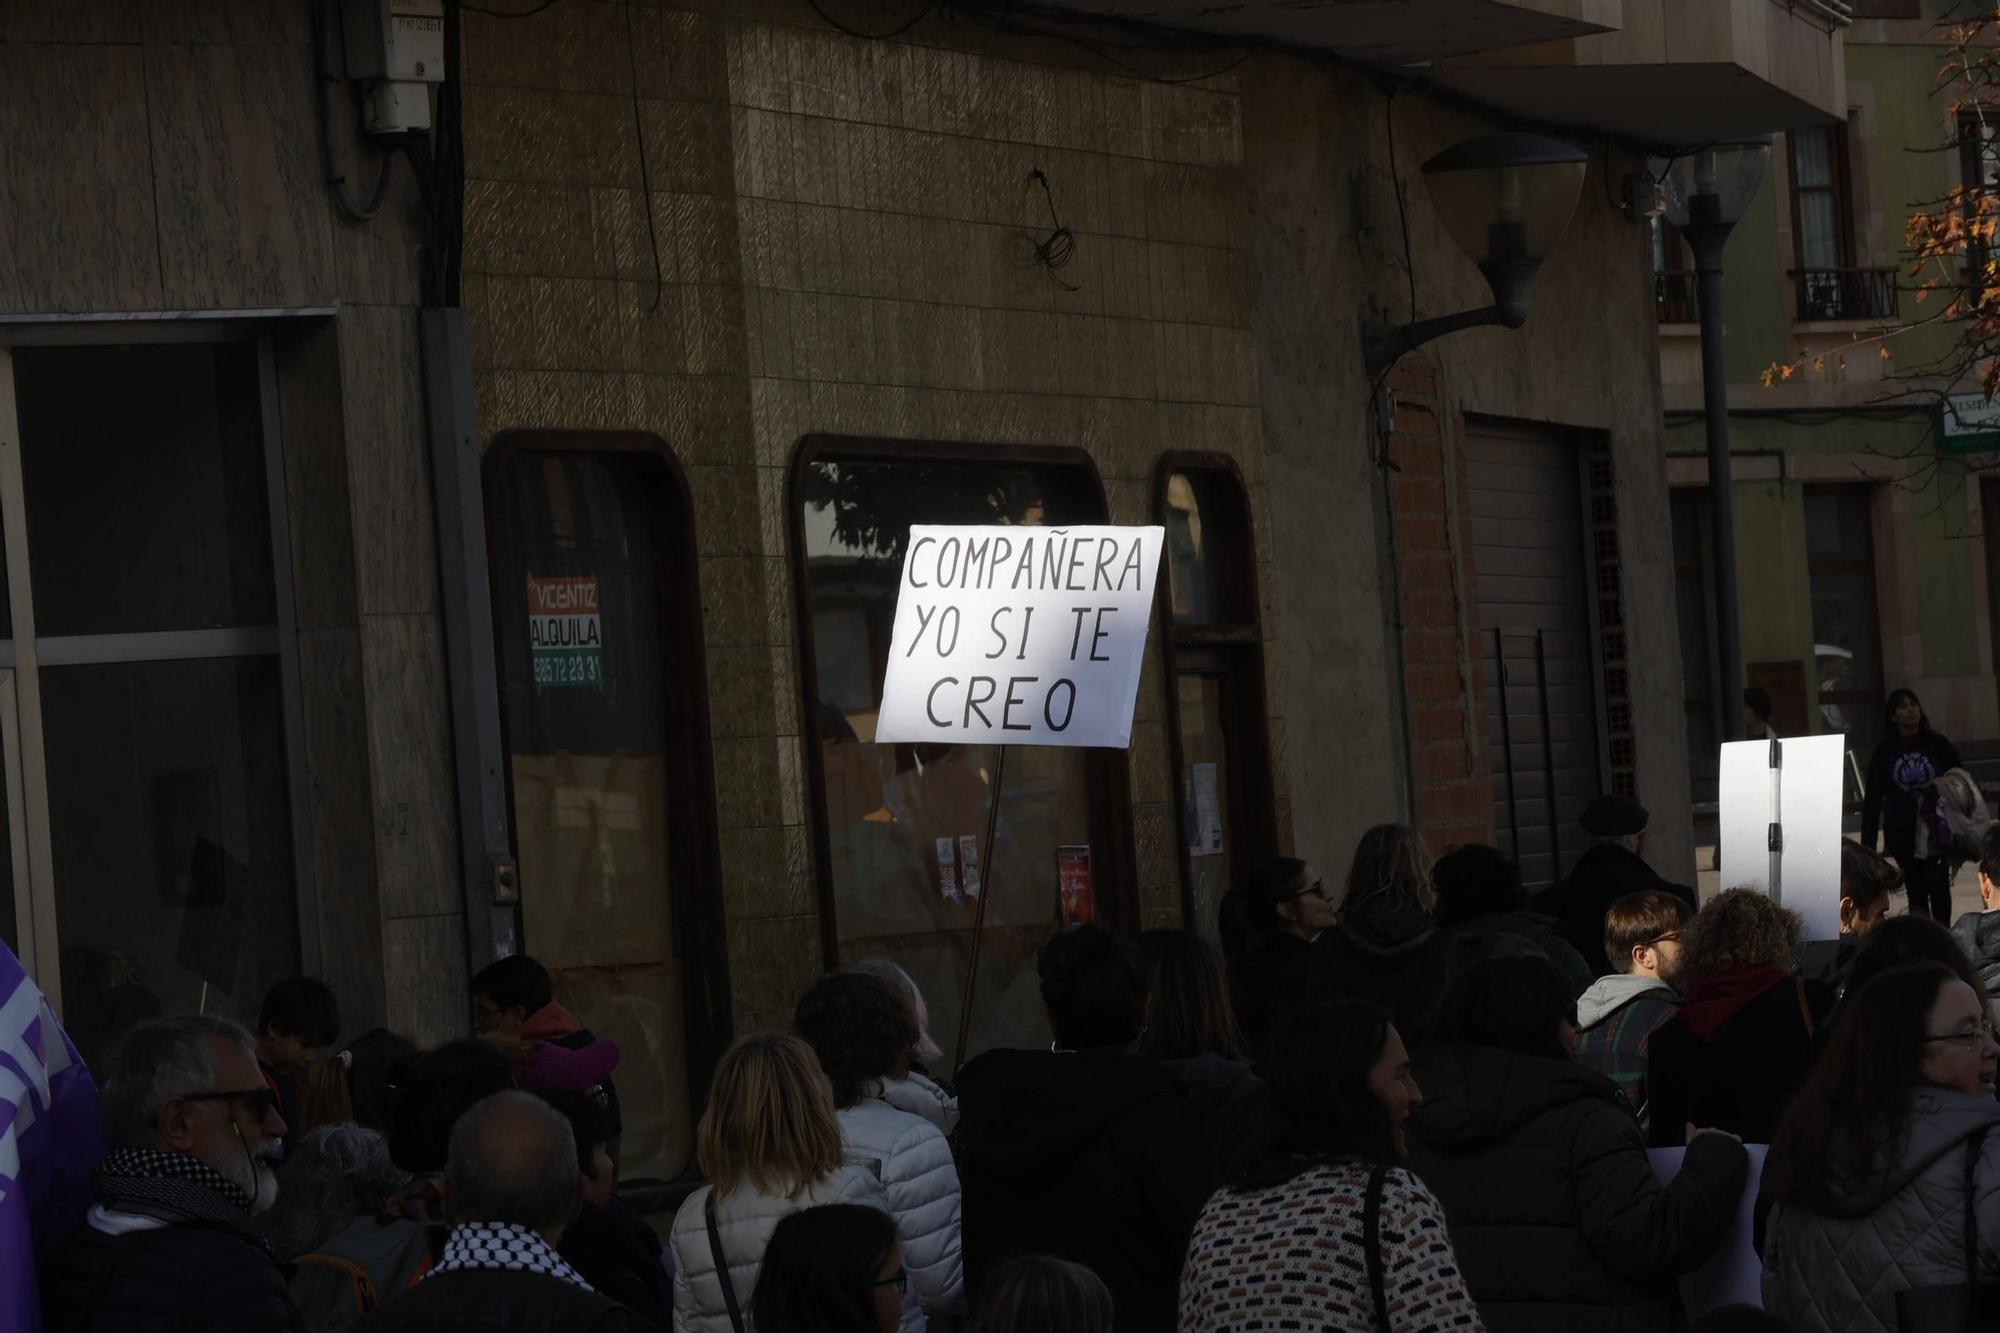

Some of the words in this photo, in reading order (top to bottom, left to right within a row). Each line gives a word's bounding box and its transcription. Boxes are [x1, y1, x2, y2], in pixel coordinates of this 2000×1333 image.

[908, 530, 1142, 592] COMPAÑERA
[531, 618, 599, 646] ALQUILA
[906, 604, 961, 658] YO
[985, 606, 1034, 660] SI
[1070, 606, 1118, 661] TE
[534, 657, 553, 683] 985
[553, 656, 567, 682] 72
[569, 655, 585, 682] 23
[587, 655, 602, 681] 31
[926, 675, 1076, 732] CREO
